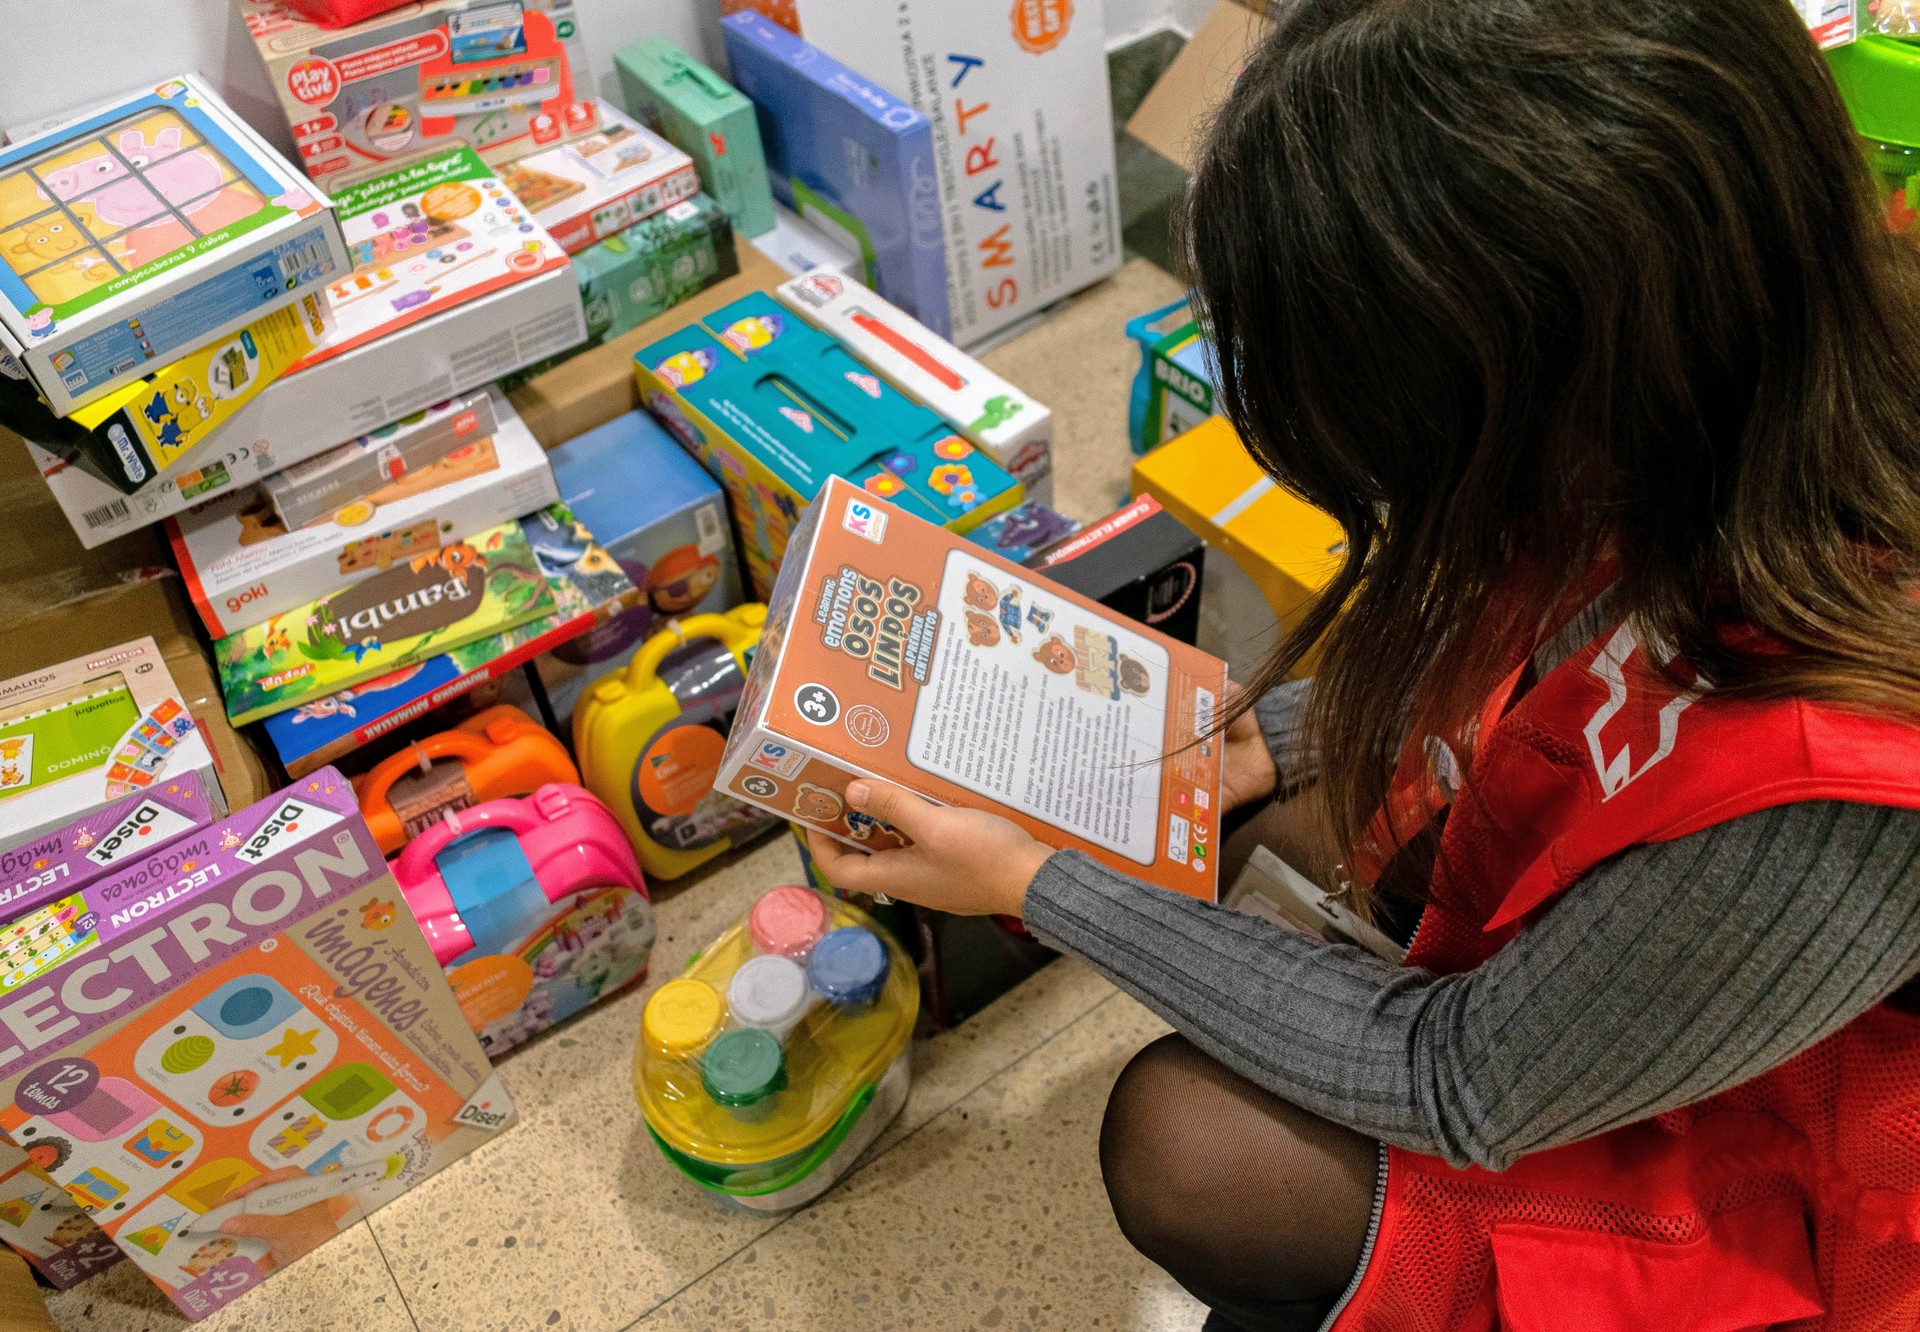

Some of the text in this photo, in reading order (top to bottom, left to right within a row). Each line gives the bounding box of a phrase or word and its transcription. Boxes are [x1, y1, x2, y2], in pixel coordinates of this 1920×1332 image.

[292, 66, 330, 88] Play
[297, 81, 334, 100] tive
[302, 119, 322, 134] 1+
[946, 52, 1018, 309] SMARTY
[108, 231, 230, 291] rompecabezas 9 cubos
[1155, 359, 1203, 403] BRIO
[117, 438, 145, 480] Mr. White
[849, 503, 872, 534] KS
[227, 582, 268, 612] goki
[337, 578, 471, 639] Bambi
[842, 576, 884, 656] OSOS
[869, 578, 919, 690] LINDOS
[904, 614, 925, 666] APRENDER
[913, 609, 938, 682] SENTIMIENTOS
[431, 668, 490, 702] MUNDUKO
[926, 722, 936, 742] juego
[932, 681, 944, 712] "Aprender
[938, 648, 949, 680] emociones
[944, 668, 958, 705] expresiones
[363, 697, 429, 739] ANIMALIAK
[803, 690, 826, 718] 3+
[974, 689, 984, 719] diferentes
[937, 713, 947, 741] contiene
[961, 711, 971, 730] padre
[970, 720, 980, 742] piezas
[992, 713, 1000, 737] colocar
[755, 743, 786, 769] KS
[933, 741, 942, 764] lindos"
[945, 734, 954, 758] emoción
[978, 731, 987, 752] Todas
[987, 738, 998, 763] pueden
[997, 746, 1007, 773] bandeja
[1004, 762, 1015, 795] personaje
[1010, 731, 1020, 752] puede
[748, 779, 770, 795] 3+
[1025, 776, 1034, 796] juego
[1043, 778, 1053, 812] establecer
[1056, 763, 1065, 797] emociones
[1053, 798, 1061, 816] entre
[95, 805, 160, 862] Diset
[245, 805, 304, 865] Diset
[101, 839, 209, 902] imágenes
[110, 863, 221, 929] LECTRON
[0, 829, 370, 1065] ECTRON
[305, 908, 429, 1032] imágenes
[46, 1064, 89, 1095] 12
[22, 1081, 62, 1111] temas
[460, 1100, 507, 1128] Diset
[77, 1240, 118, 1269] +2
[209, 1269, 250, 1299] +2
